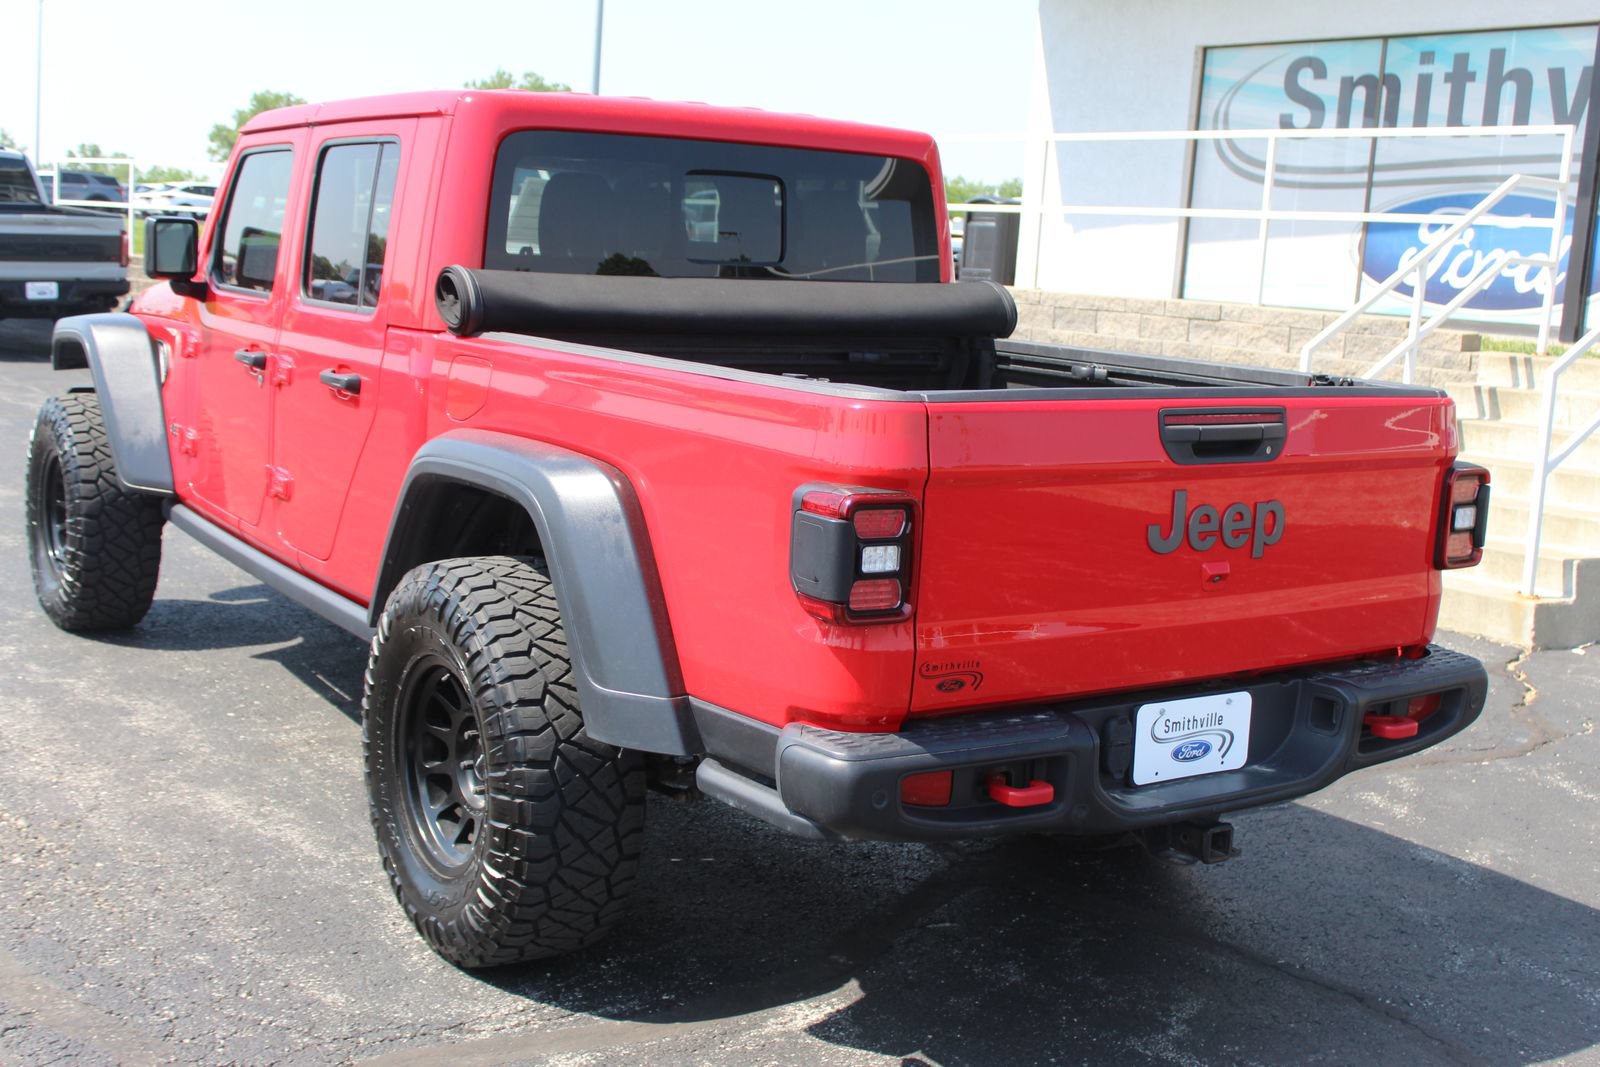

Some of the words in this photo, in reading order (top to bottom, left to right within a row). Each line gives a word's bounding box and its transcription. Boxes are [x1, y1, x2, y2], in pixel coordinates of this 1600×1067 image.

[1398, 207, 1573, 295] Ford
[1147, 489, 1286, 558] Jeep
[1164, 712, 1224, 733] Smithville
[1178, 743, 1205, 759] Ford
